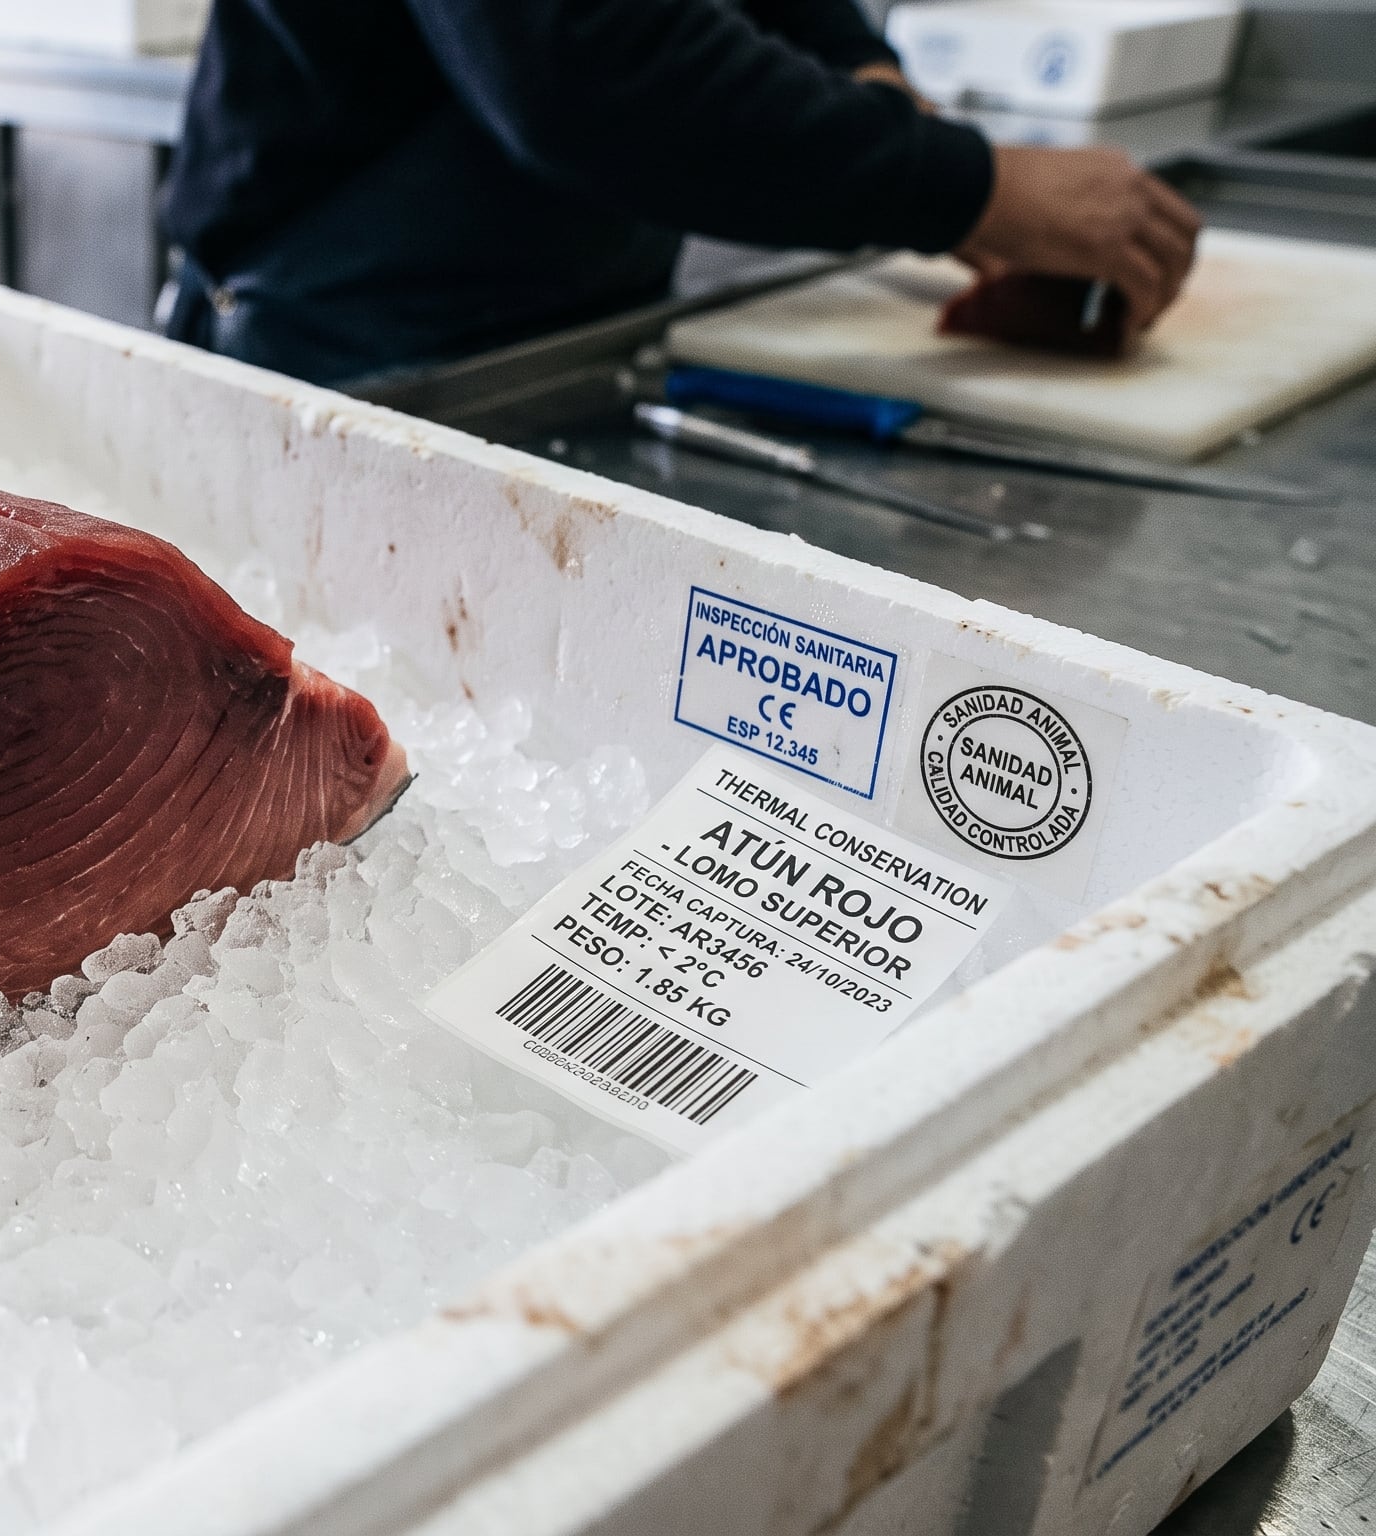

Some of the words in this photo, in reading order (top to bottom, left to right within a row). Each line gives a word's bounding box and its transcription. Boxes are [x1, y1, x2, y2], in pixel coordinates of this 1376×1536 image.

[695, 601, 790, 649] INSPECCIÓN
[795, 635, 884, 682] SANITARIA
[696, 634, 871, 717] APROBADO
[727, 715, 760, 740] ESP
[766, 732, 818, 765] 12.345
[943, 694, 1023, 728] SANIDAD
[1027, 707, 1081, 774] ANIMAL
[960, 737, 1052, 786] SANIDAD
[928, 751, 967, 826] CALIDAD
[967, 805, 1079, 852] CONTROLADA
[960, 764, 1038, 810] ANIMAL
[700, 820, 811, 887] ATÚN
[809, 873, 923, 943] ROJO
[715, 768, 809, 831] THERMAL
[814, 823, 988, 915] CONSERVATION
[581, 892, 654, 948] TEMP:
[658, 946, 677, 960] <
[674, 955, 725, 989] 2°C
[599, 874, 673, 926] LOTE:
[669, 921, 769, 979] AR3456
[621, 860, 685, 904] FECHA
[686, 898, 786, 958] CAPTURA:
[785, 952, 892, 1013] 24/10/2023
[674, 845, 758, 898] LOMO
[761, 892, 912, 980] SUPERIOR
[553, 914, 630, 973] PESO:
[634, 966, 689, 1004] 1.85
[686, 996, 731, 1027] KG
